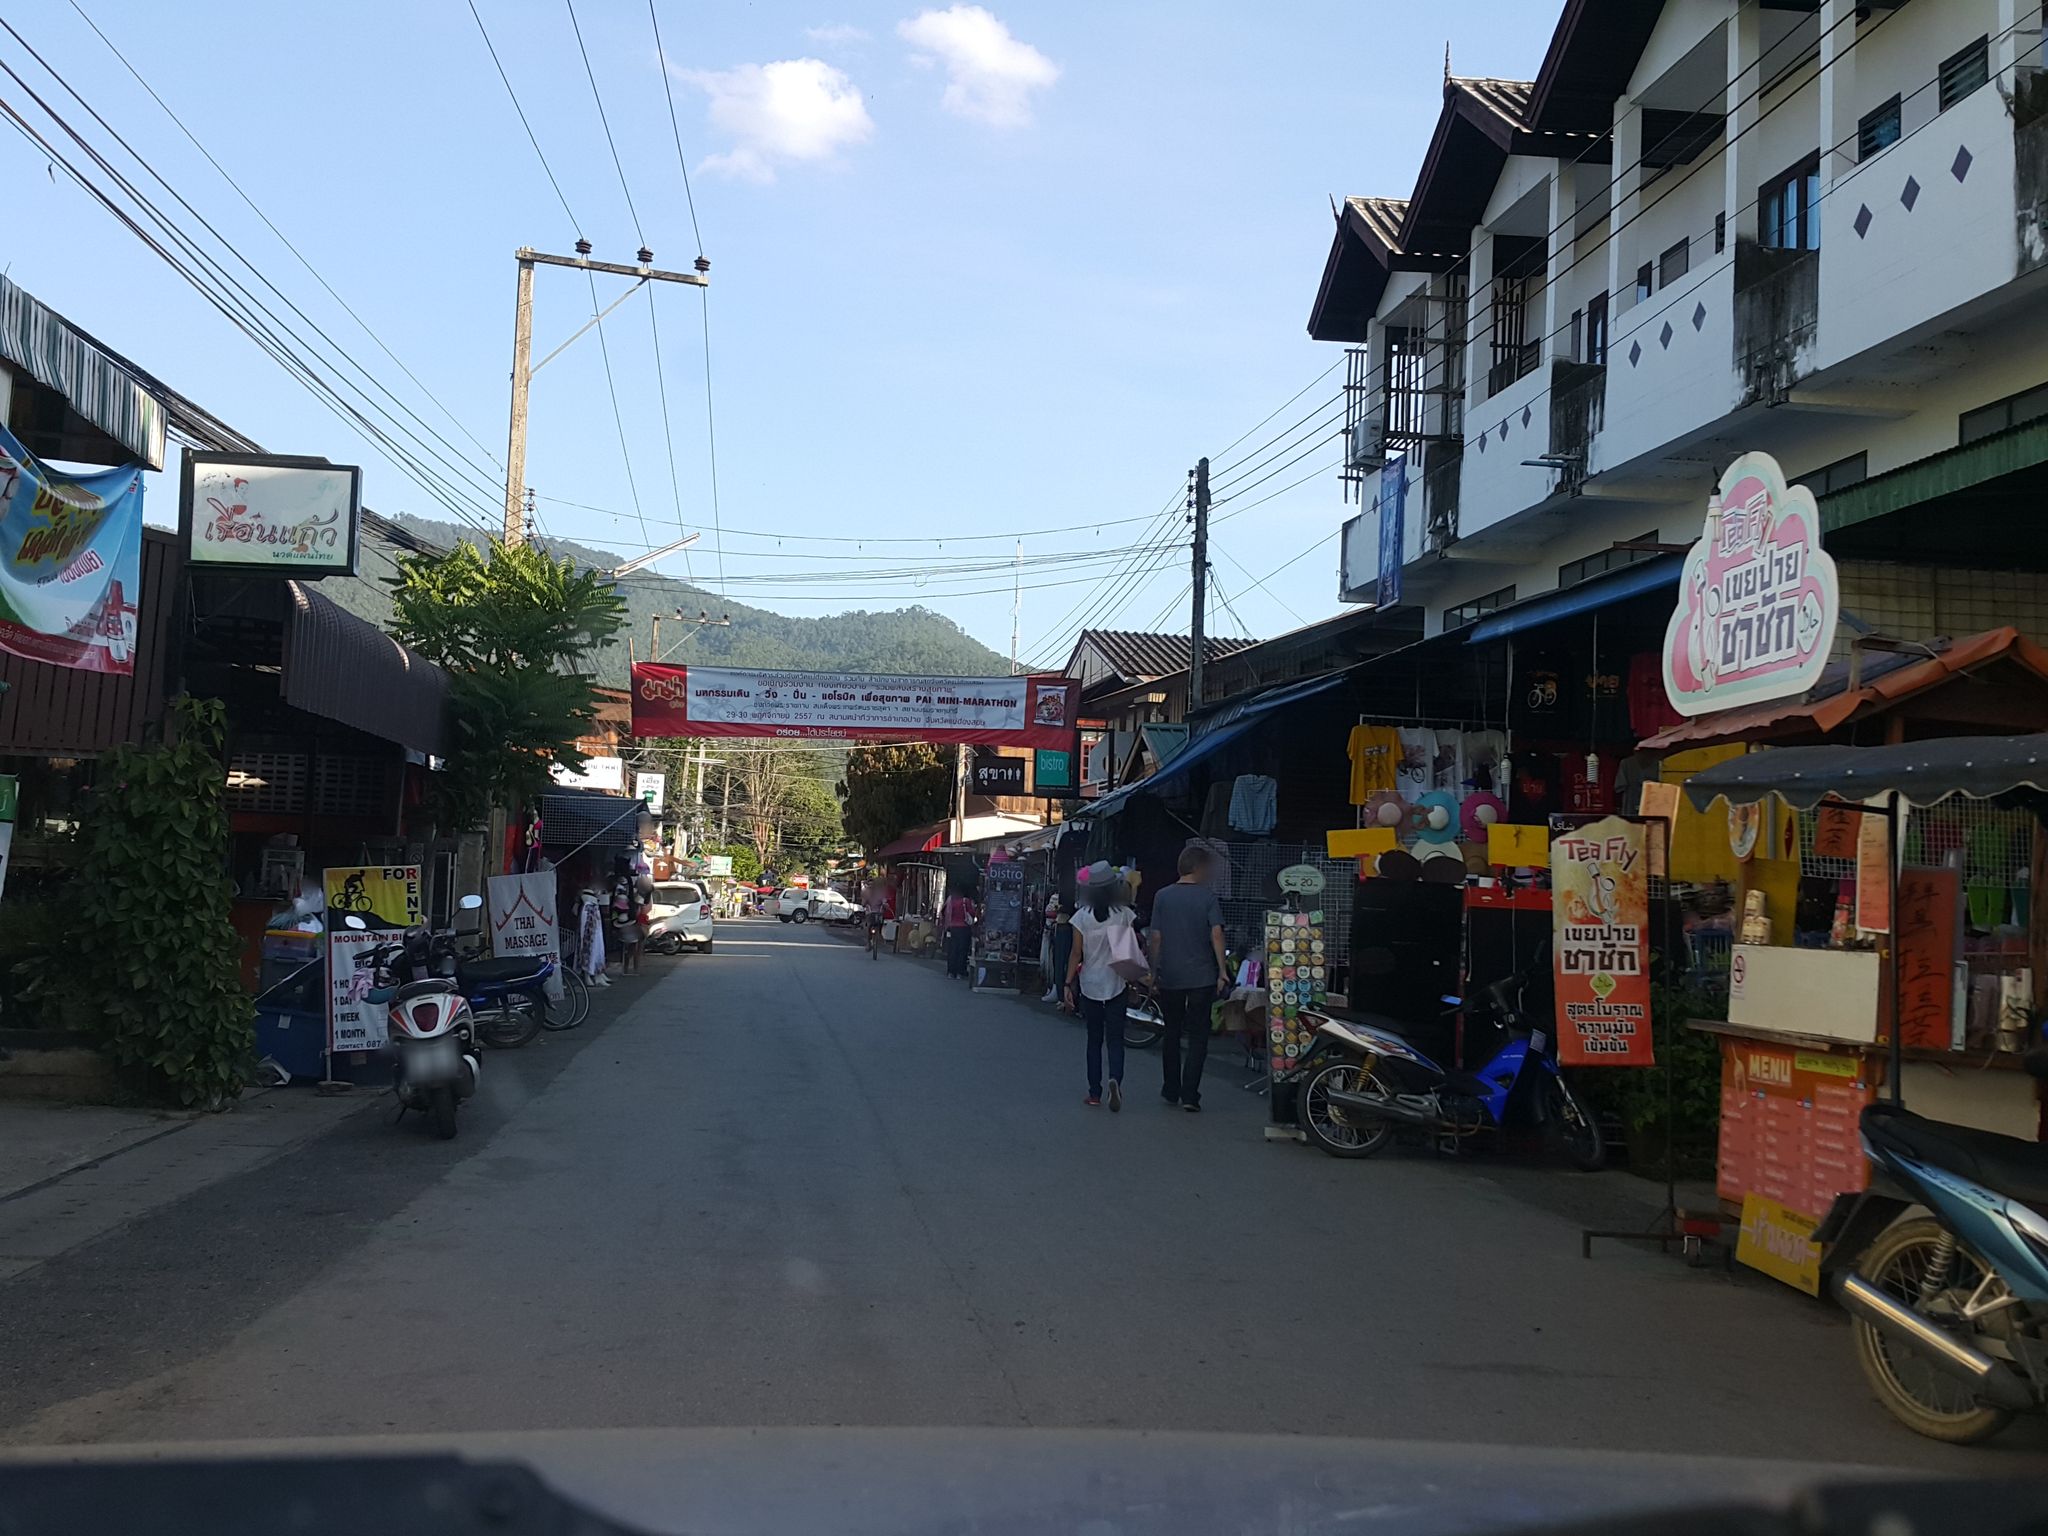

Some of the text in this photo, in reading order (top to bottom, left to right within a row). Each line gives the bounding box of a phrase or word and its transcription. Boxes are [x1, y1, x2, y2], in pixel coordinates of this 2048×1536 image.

[1726, 550, 1799, 603] เขยปาย
[1721, 593, 1796, 666] ชาชัก
[695, 689, 750, 698] มหกรรมเดิน
[861, 691, 911, 704] เพื่อสุขภาพ
[915, 695, 932, 704] PAI
[937, 696, 1017, 708] MINI-MARATHON
[726, 711, 748, 719] 29-30
[751, 711, 790, 720] พฤศจิกายน
[794, 712, 813, 720] 2557
[1040, 755, 1064, 772] bistro
[978, 767, 1007, 786] สุขา
[990, 867, 1023, 880] bistro
[514, 916, 535, 930] THAI
[334, 934, 389, 943] MOUNTAIN
[505, 933, 548, 950] MASSAGE
[1564, 924, 1637, 942] เขยปาย
[1563, 942, 1638, 972] ชาชัก
[340, 1011, 360, 1022] WEEK
[1566, 998, 1644, 1020] สูตรโบราณ
[340, 1029, 366, 1040] MONTH
[1576, 1018, 1635, 1035] หวานมัน
[1584, 1037, 1628, 1053] เข้มข้น
[1749, 1054, 1792, 1083] MENU
